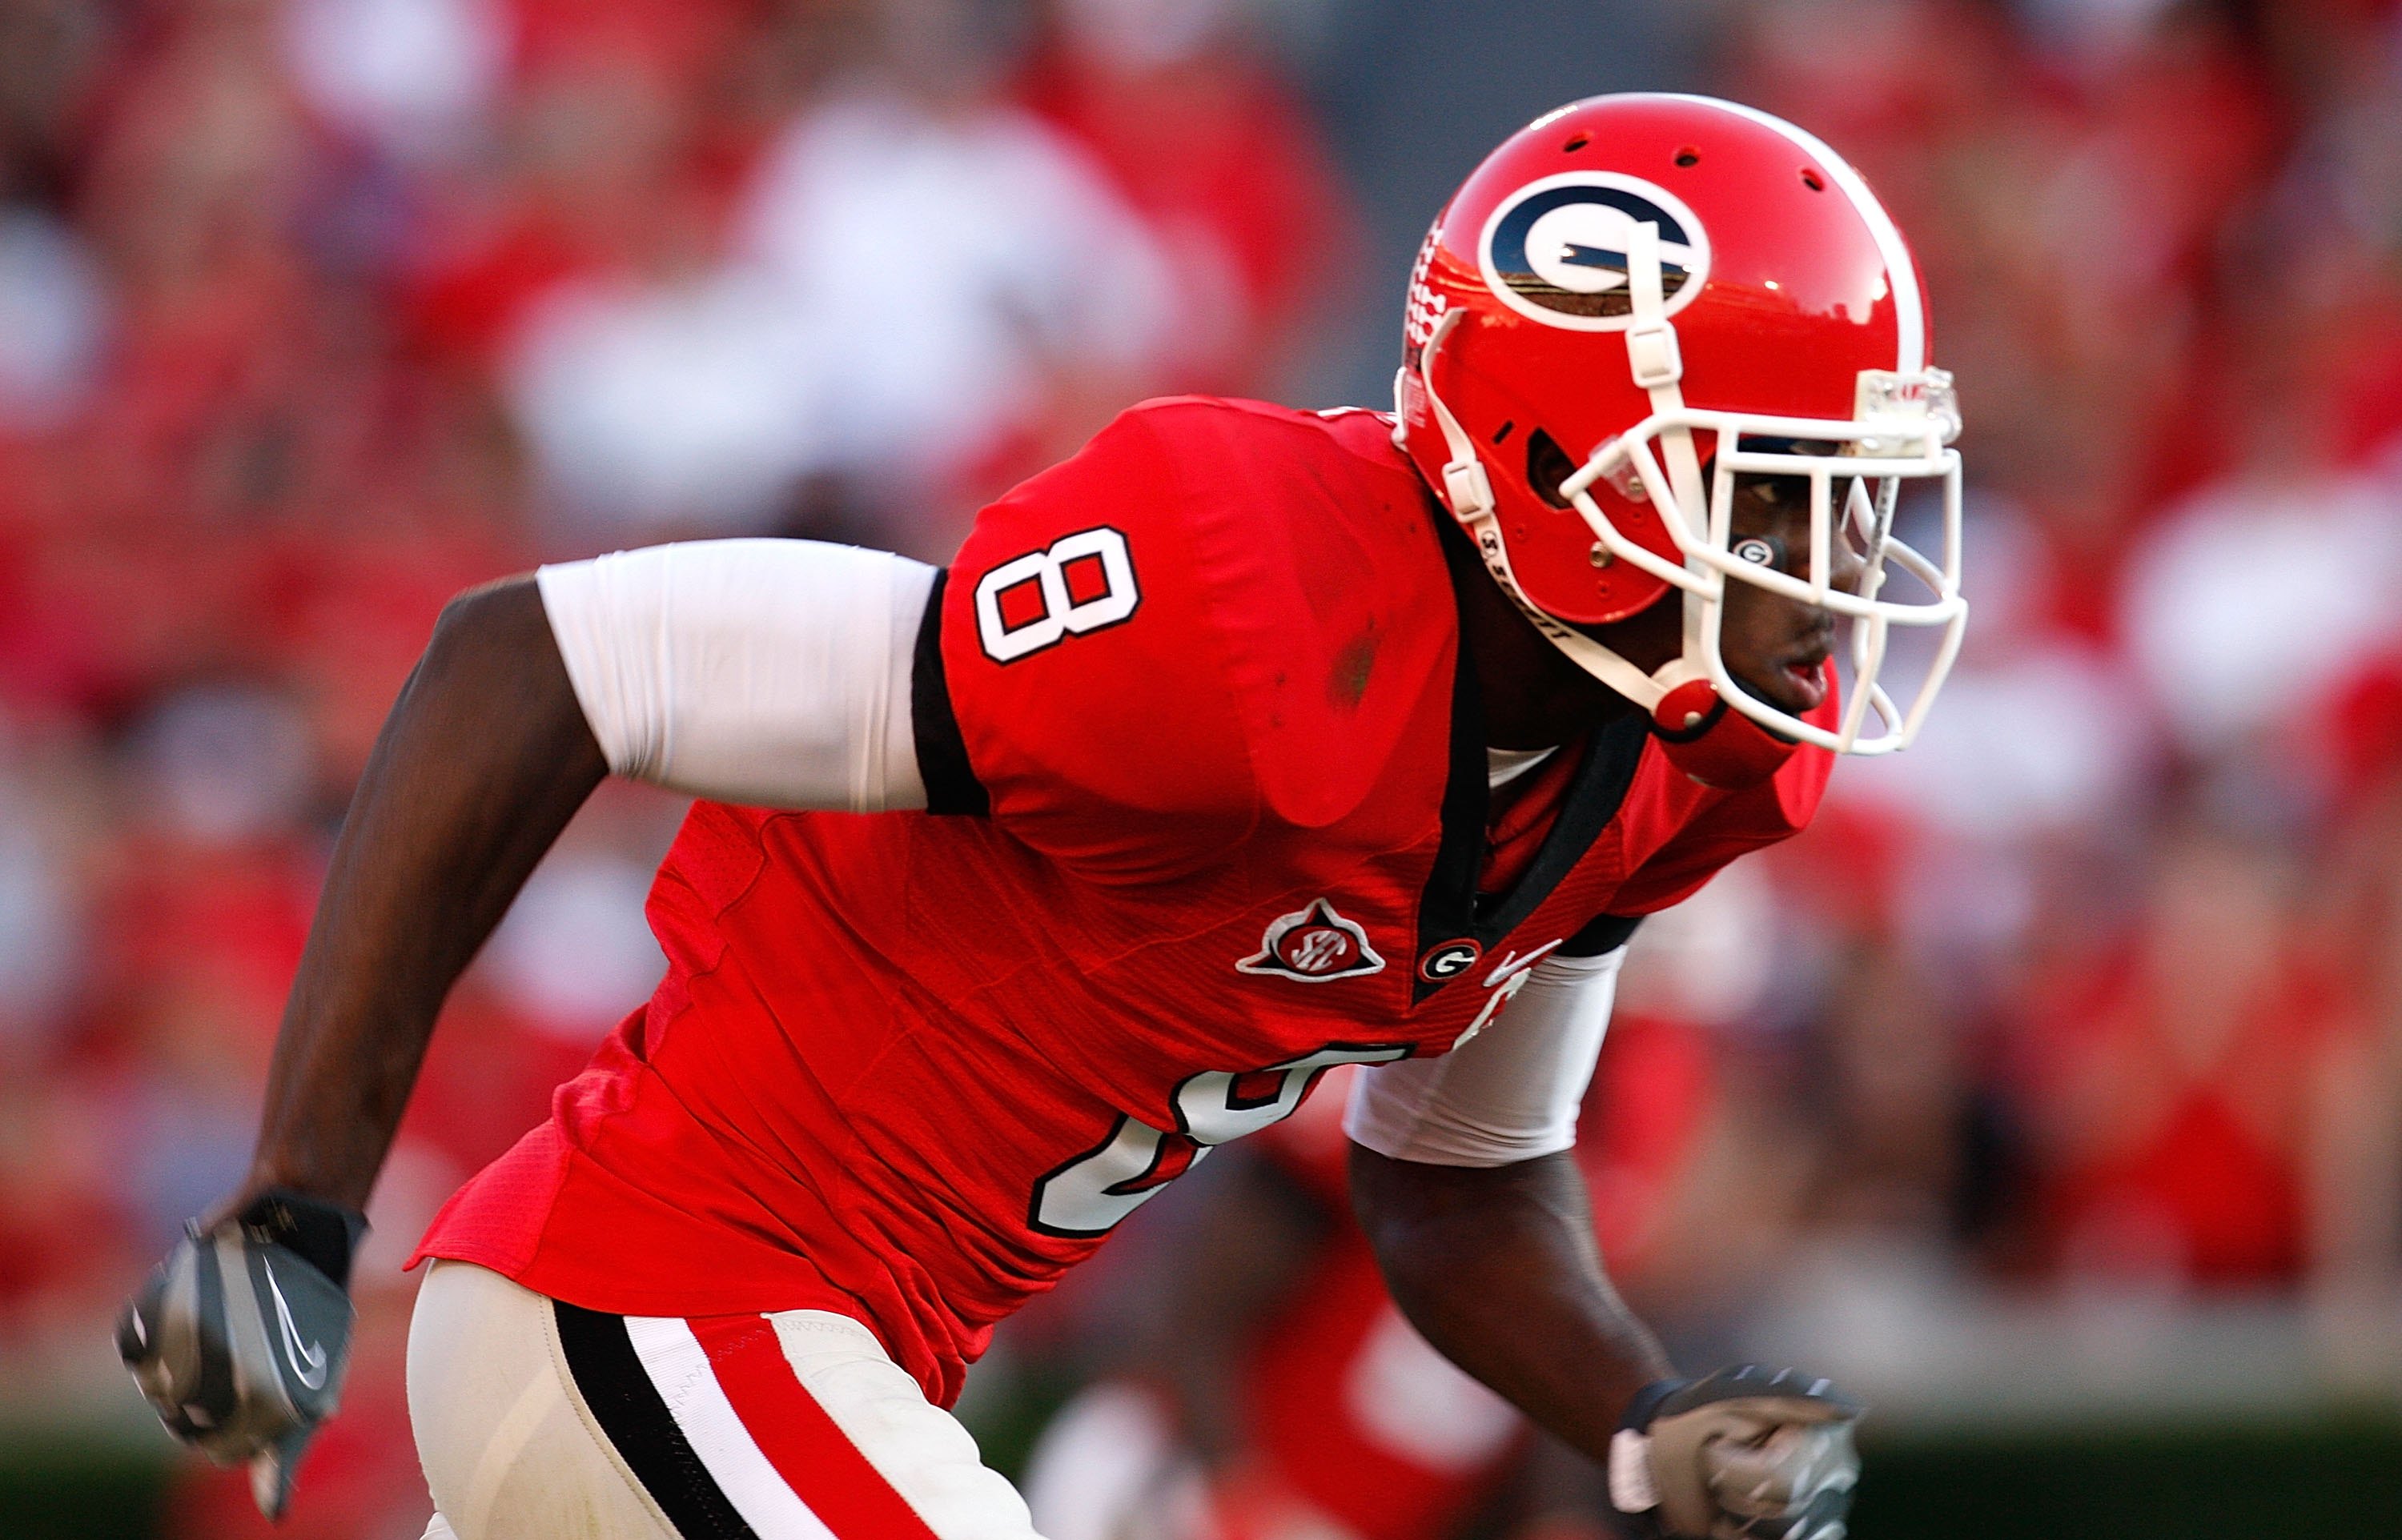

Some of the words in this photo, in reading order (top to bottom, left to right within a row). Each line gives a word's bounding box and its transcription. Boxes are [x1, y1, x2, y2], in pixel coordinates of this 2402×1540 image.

[1490, 184, 1692, 318] G
[973, 524, 1143, 667] 8
[1738, 543, 1768, 563] G
